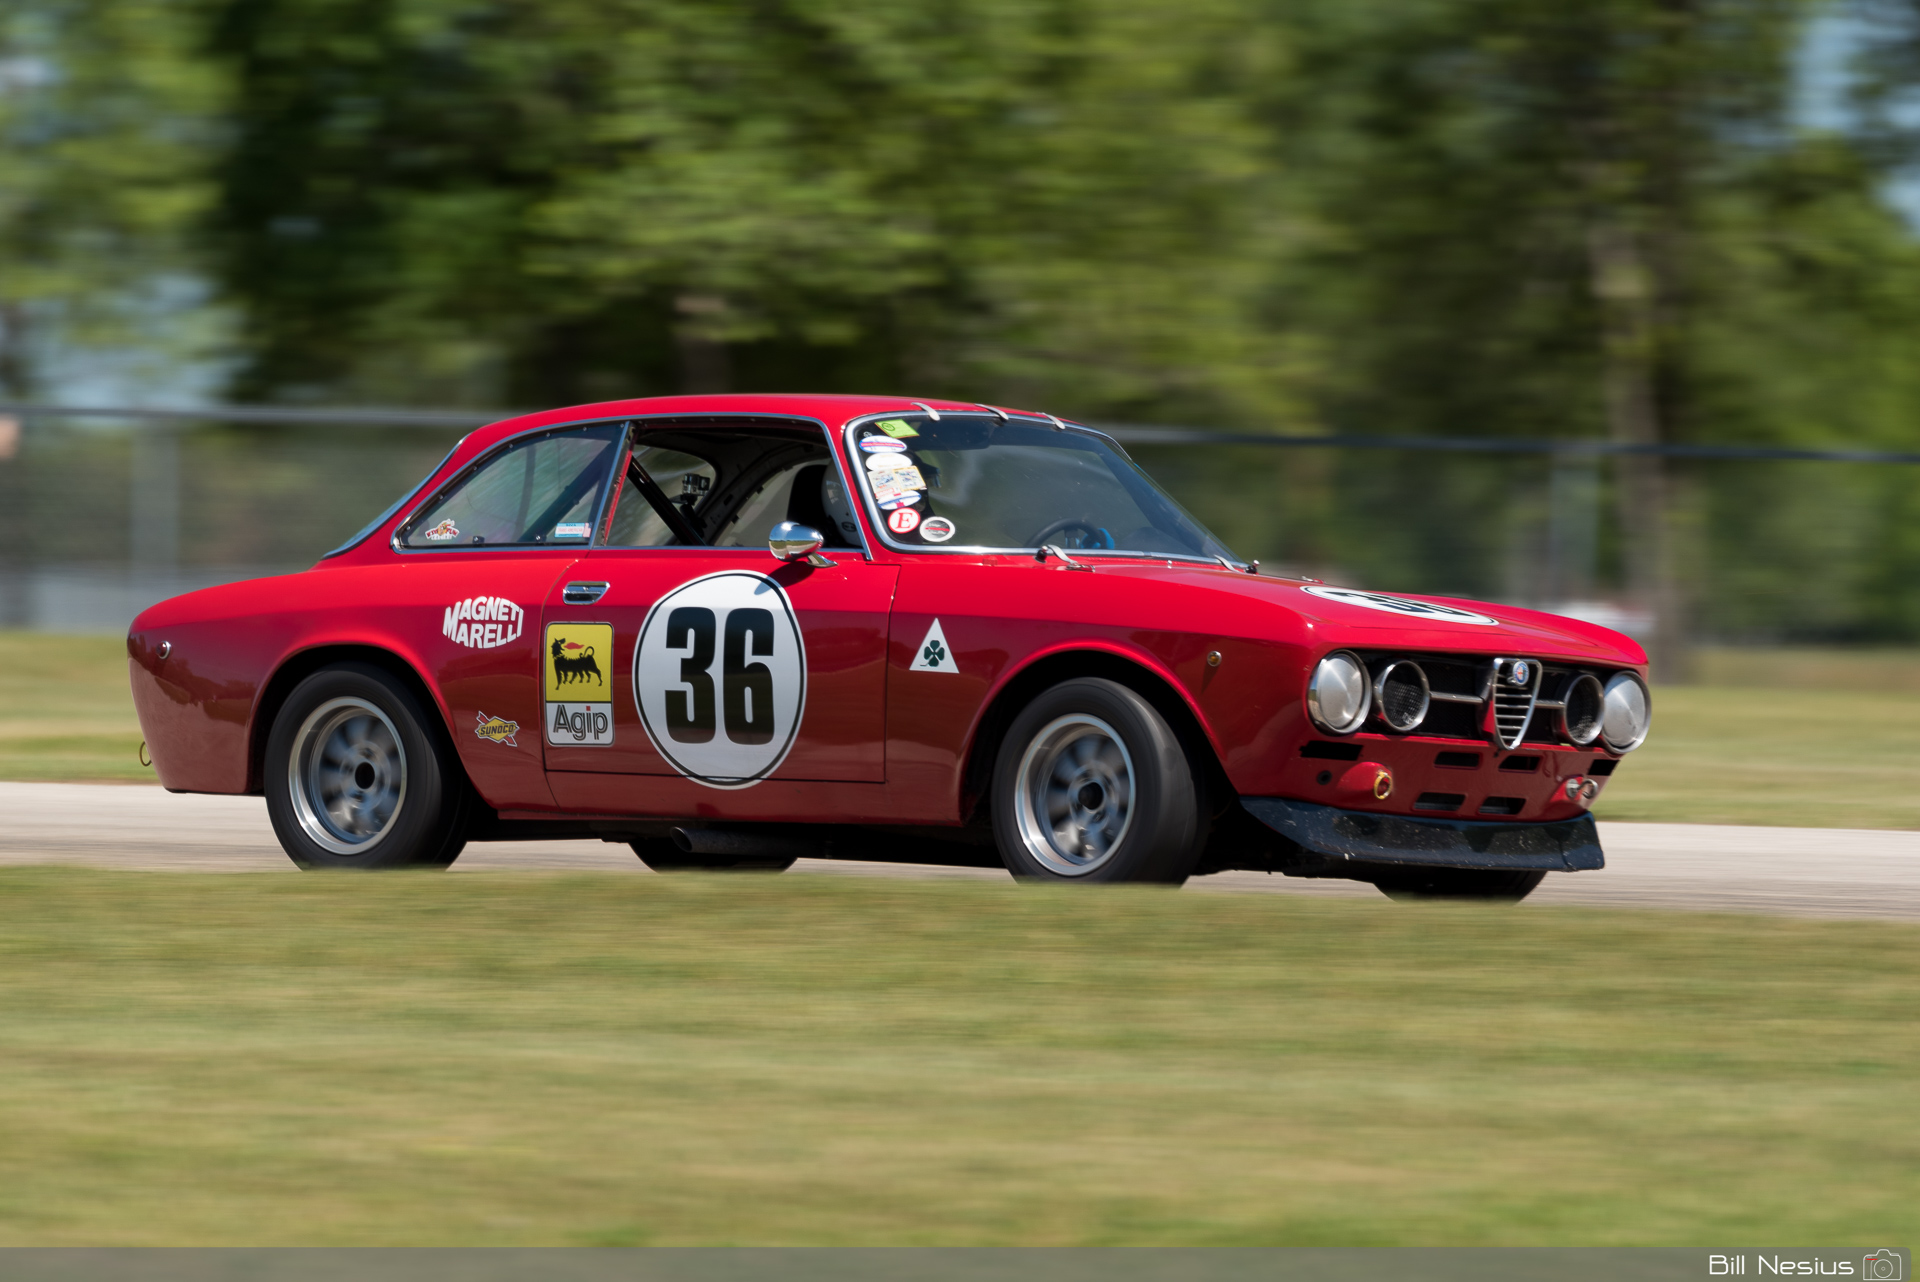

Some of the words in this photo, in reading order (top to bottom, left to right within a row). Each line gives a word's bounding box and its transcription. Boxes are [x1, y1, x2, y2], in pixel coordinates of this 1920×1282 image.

[895, 512, 913, 529] E
[443, 596, 524, 637] MAGNETI
[443, 618, 524, 649] MARELLI
[665, 606, 775, 745] 36
[479, 724, 515, 737] SUNOCO
[553, 704, 609, 741] Agip
